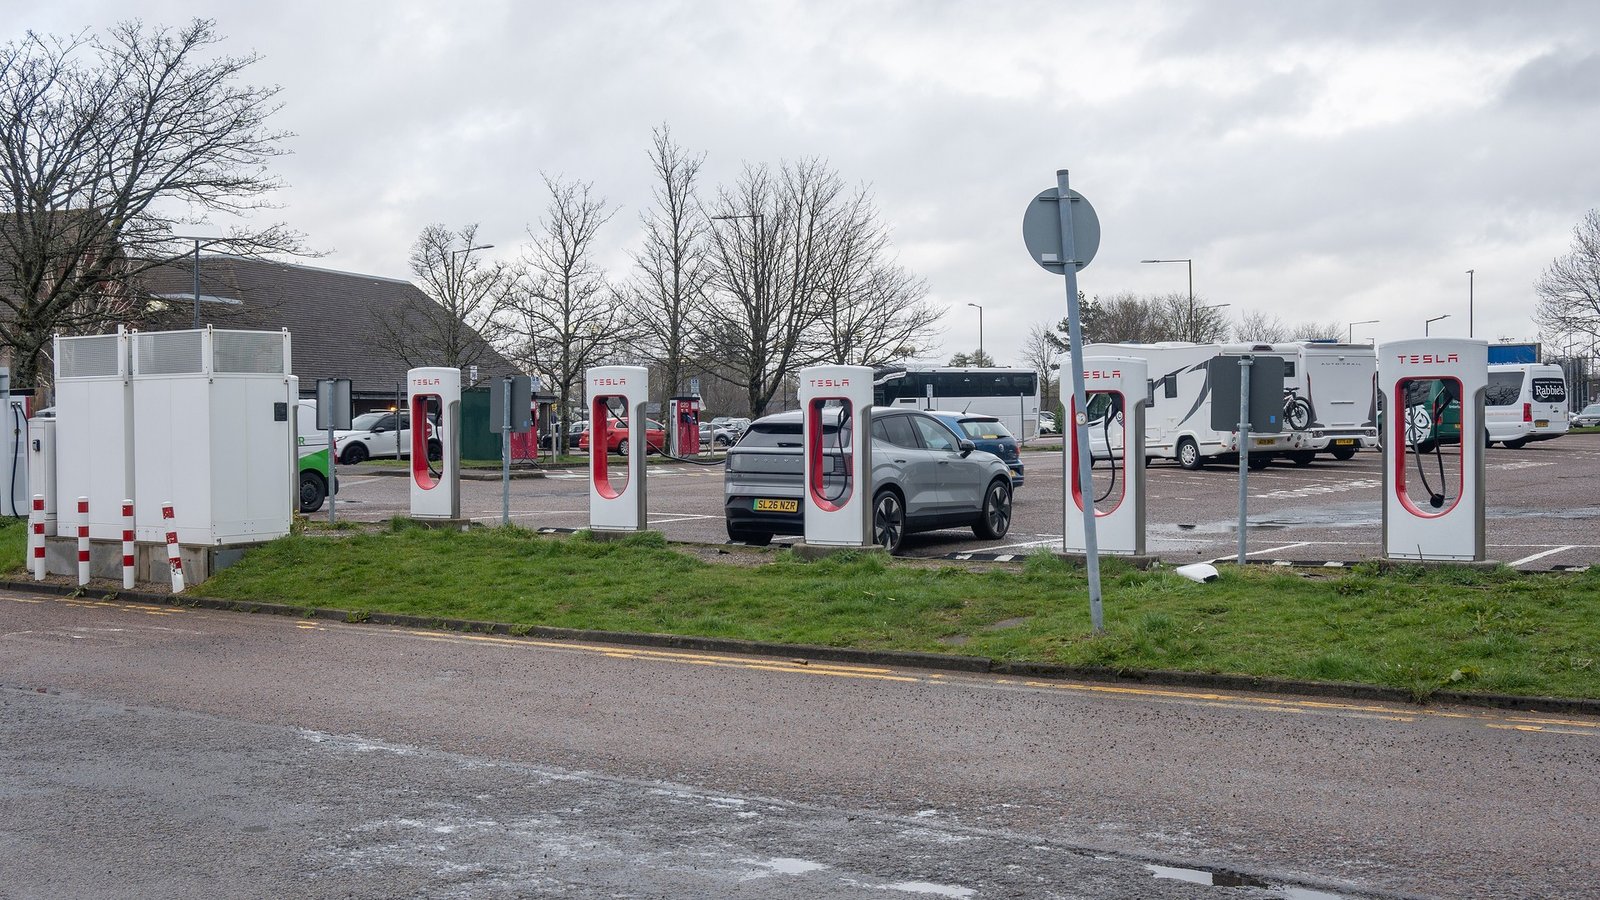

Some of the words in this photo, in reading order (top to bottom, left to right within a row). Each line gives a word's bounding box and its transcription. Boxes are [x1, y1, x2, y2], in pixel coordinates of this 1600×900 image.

[1397, 354, 1458, 364] TESLA
[1083, 371, 1121, 379] ESLA
[594, 378, 626, 386] TESLA
[810, 379, 849, 387] TESLA
[1535, 385, 1565, 398] Rabbie's
[758, 499, 778, 509] SL26
[780, 500, 796, 510] NZR
